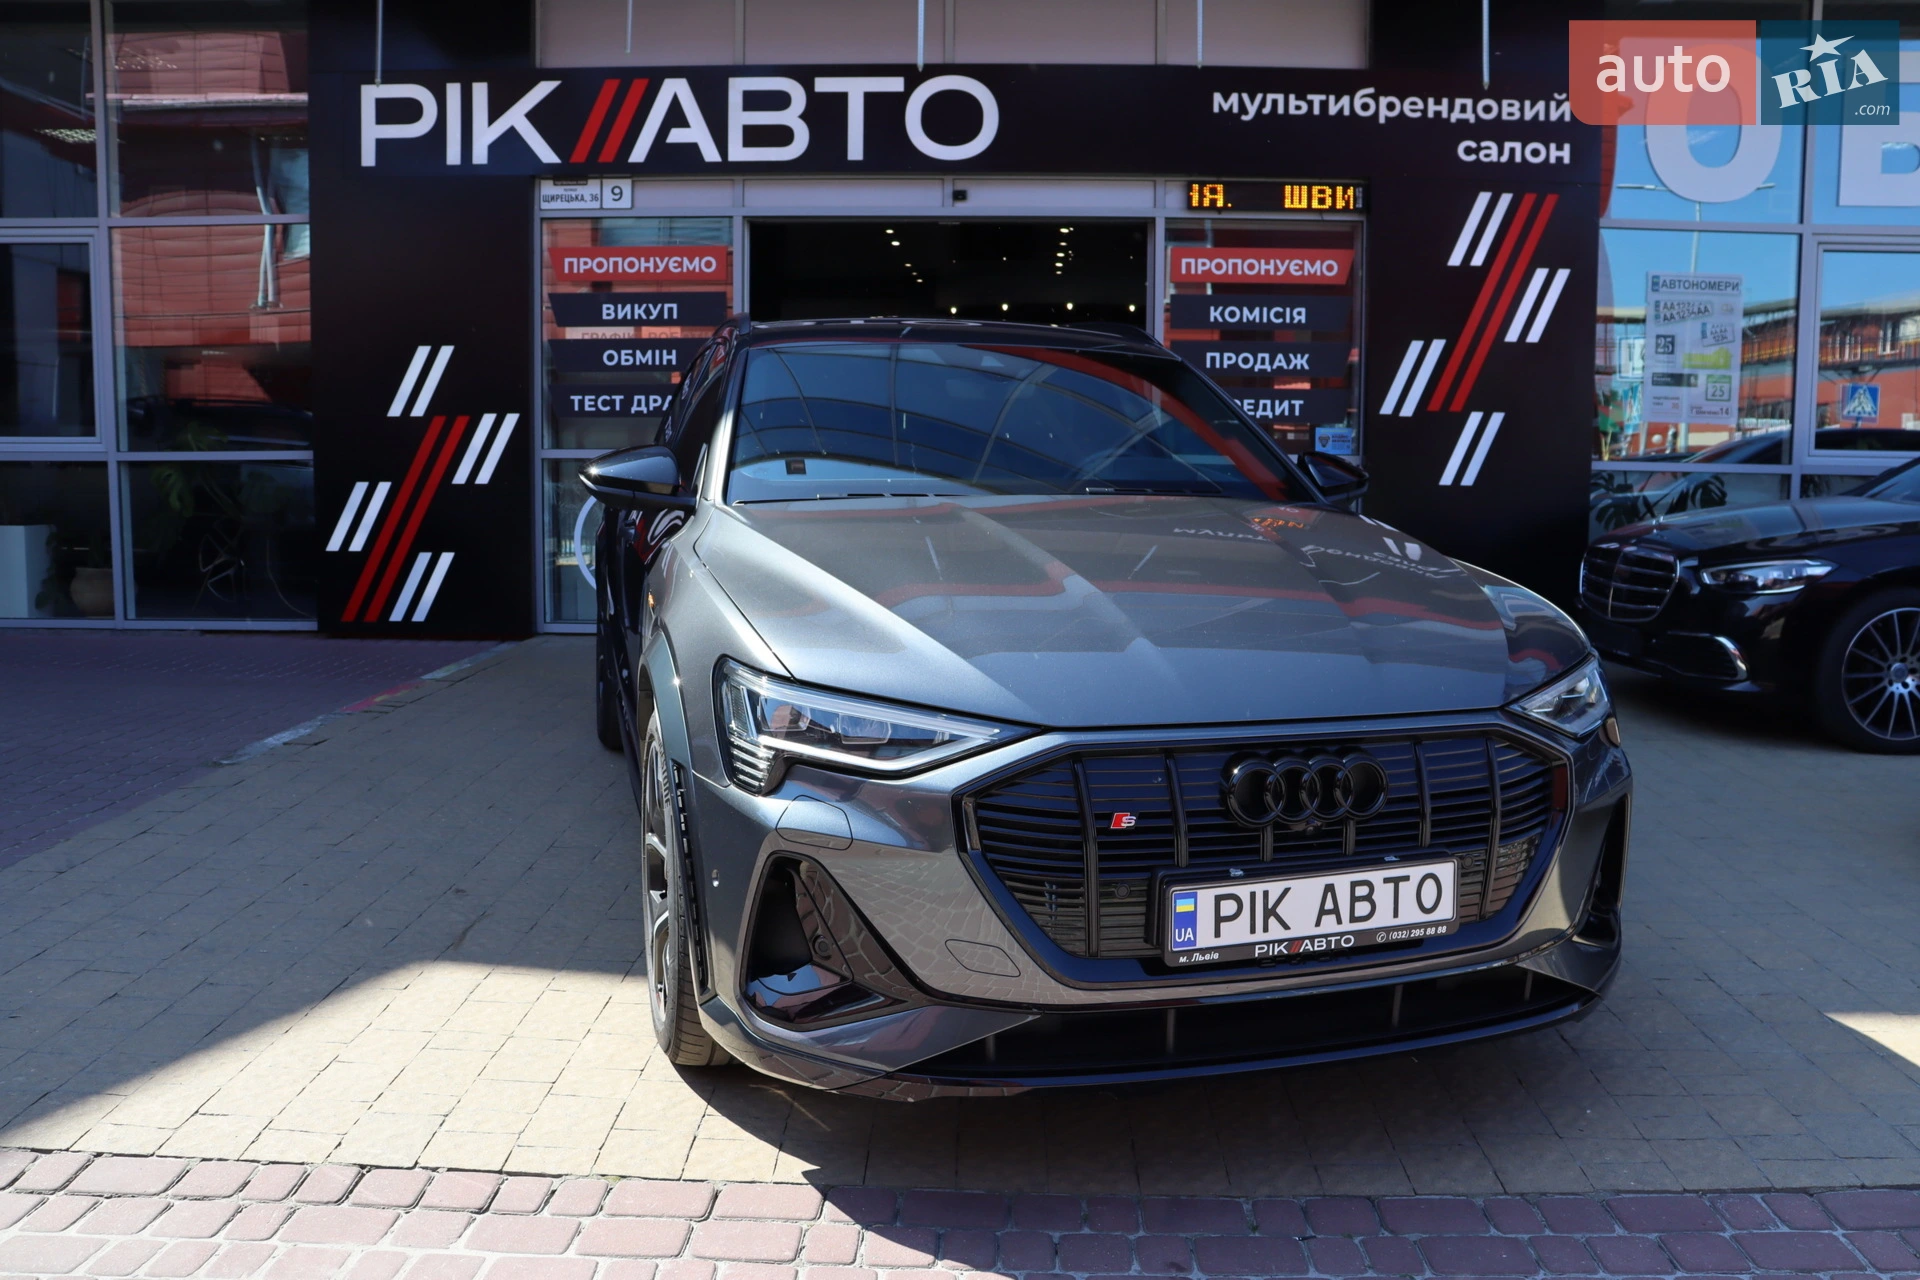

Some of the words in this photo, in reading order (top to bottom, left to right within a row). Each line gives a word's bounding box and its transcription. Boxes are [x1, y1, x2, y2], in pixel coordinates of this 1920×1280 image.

[1212, 87, 1572, 124] мультибрендовий
[1457, 140, 1571, 164] салон
[589, 193, 599, 202] 36
[611, 185, 623, 202] 9
[563, 256, 717, 274] ПРОПОНУЄМО
[1181, 257, 1338, 277] ПРОПОНУЄМО
[1661, 279, 1740, 292] АВТОНОМЕРИ
[602, 303, 678, 320] ВИКУП
[1209, 305, 1307, 324] КОМІСІЯ
[1658, 337, 1673, 353] 25
[602, 350, 677, 366] ОБМІН
[1205, 352, 1310, 372] ПРОДАЖ
[1711, 385, 1725, 398] 25
[570, 395, 624, 412] ТЕСТ
[1175, 928, 1194, 942] UA
[1389, 930, 1409, 940] (032)
[1411, 928, 1424, 937] 295
[1426, 927, 1436, 935] 88
[1437, 925, 1447, 934] 88
[1191, 951, 1219, 962] Львів
